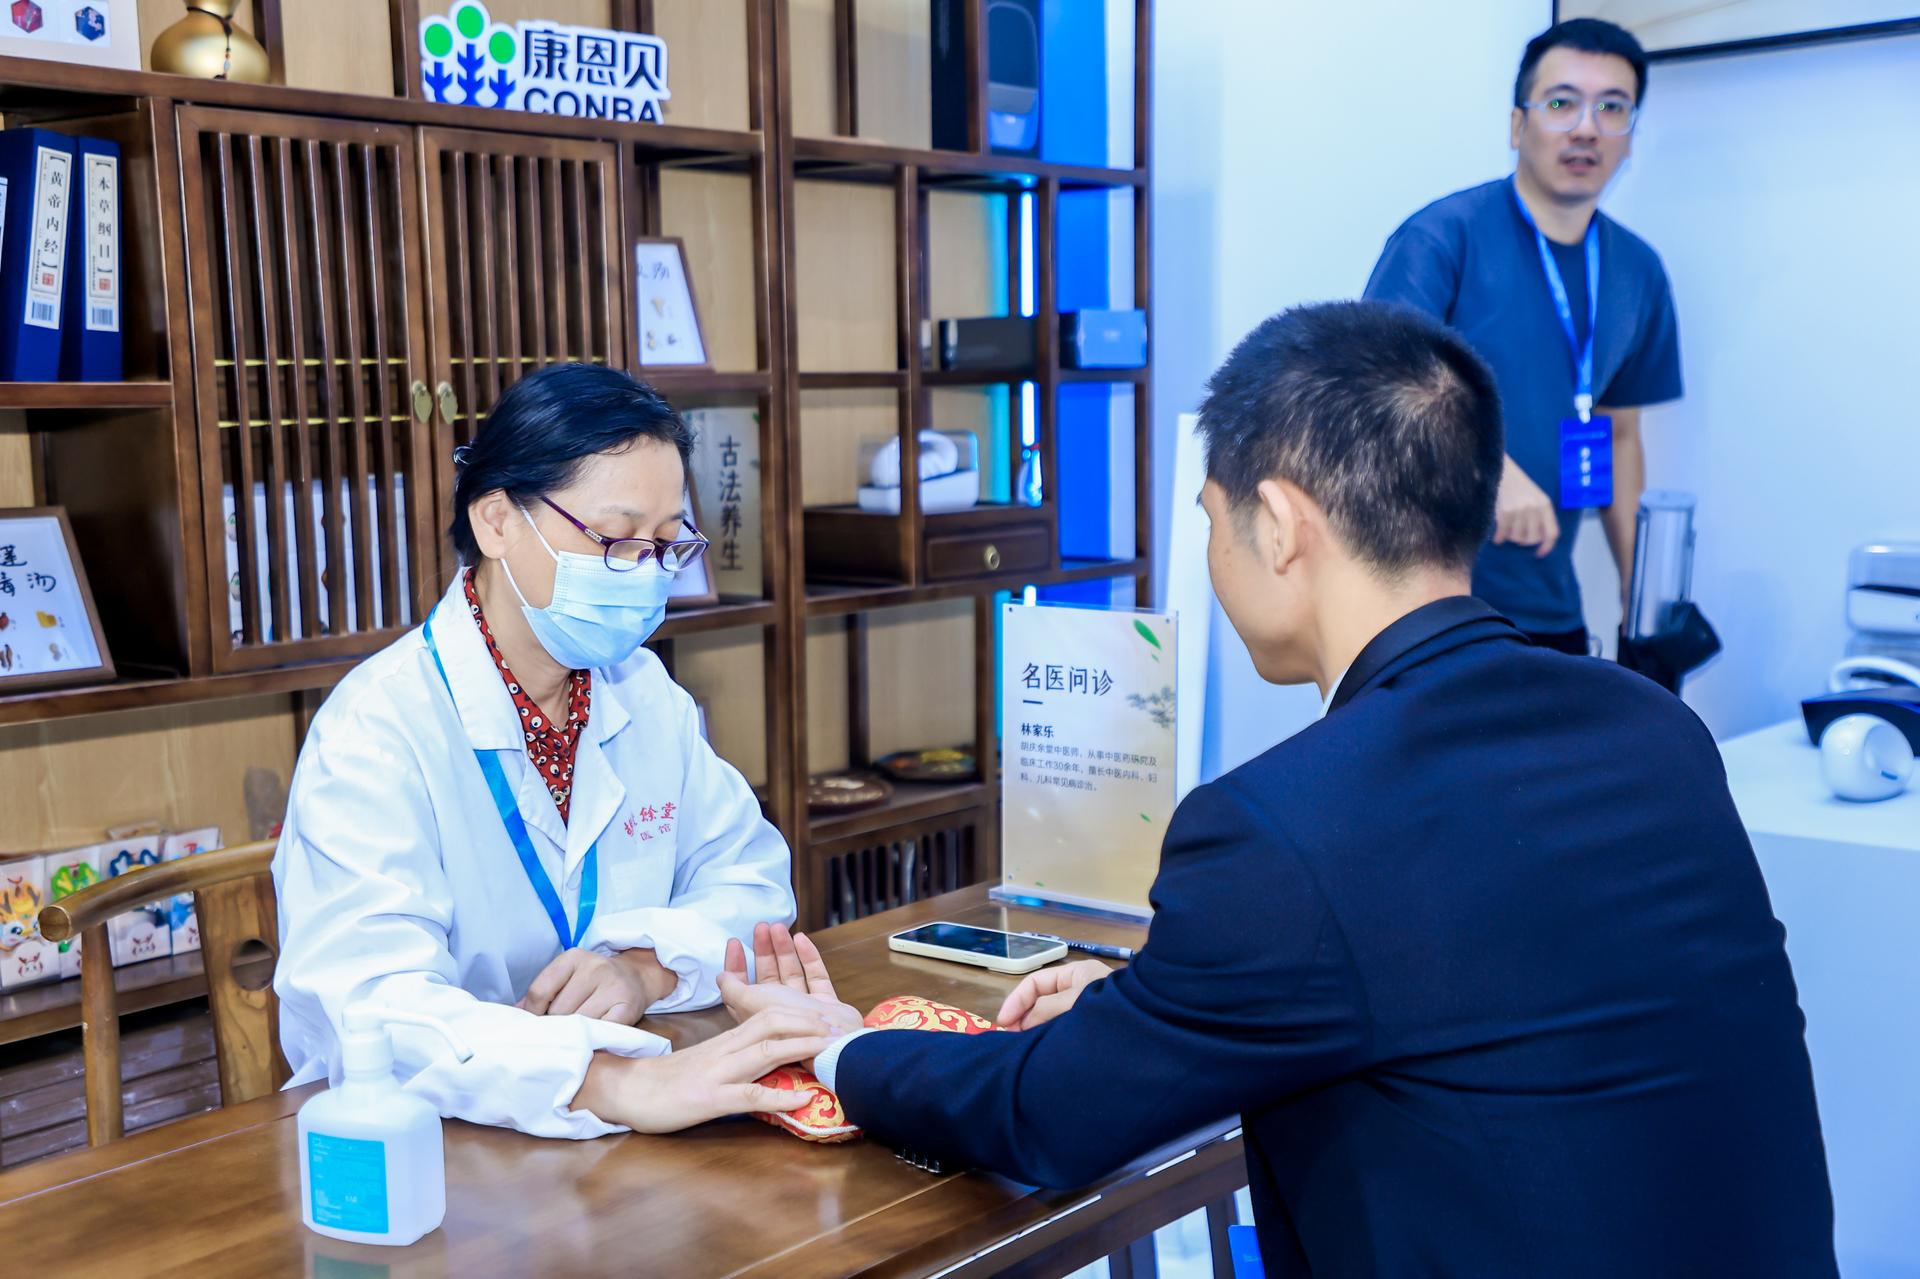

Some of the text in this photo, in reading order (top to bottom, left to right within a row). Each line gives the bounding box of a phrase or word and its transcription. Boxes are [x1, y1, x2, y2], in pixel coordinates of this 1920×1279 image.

[523, 28, 661, 91] 康恩贝
[523, 88, 657, 123] CONBA
[718, 435, 743, 572] 古法养生
[1021, 662, 1114, 697] 名医问诊
[1020, 722, 1055, 739] 林家乐
